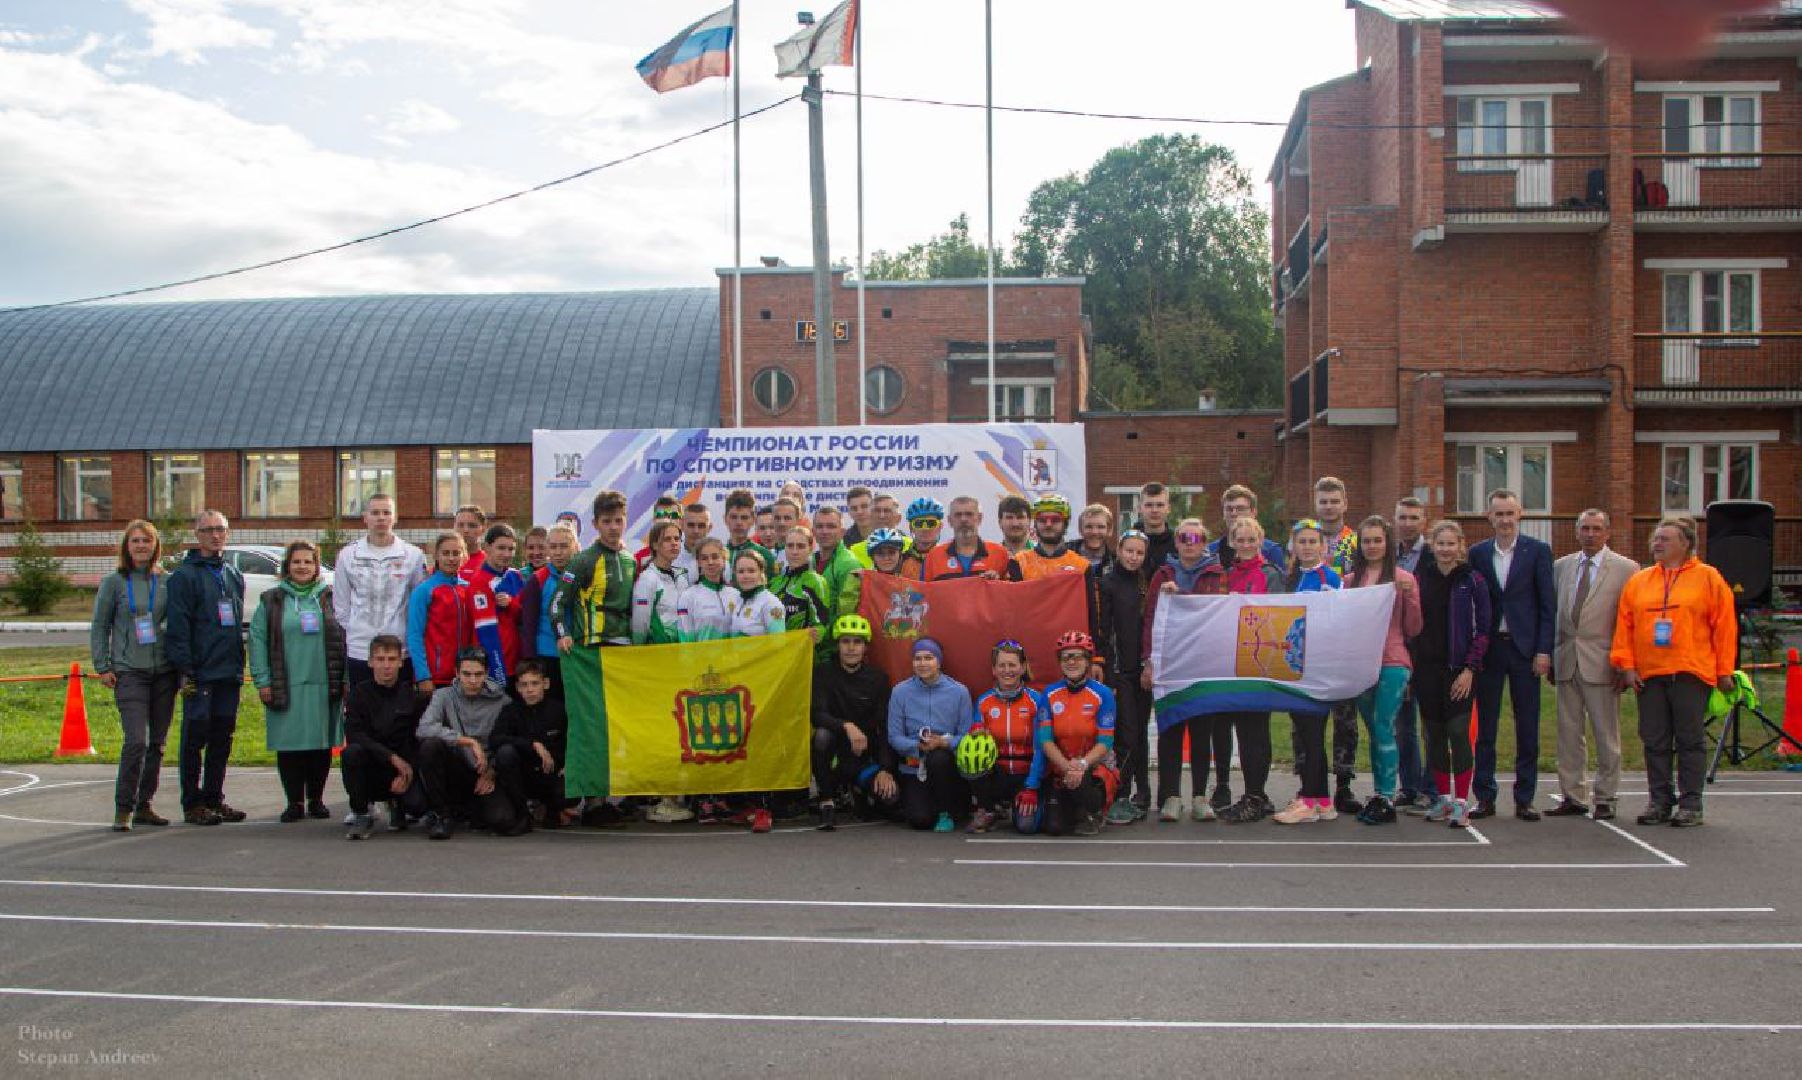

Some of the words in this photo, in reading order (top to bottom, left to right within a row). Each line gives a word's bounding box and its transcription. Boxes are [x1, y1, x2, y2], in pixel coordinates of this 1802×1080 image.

[687, 436, 823, 452] ЧЕМПИОНАТ
[829, 435, 920, 451] РОССИИ
[646, 458, 678, 474] ПО
[684, 456, 848, 473] СПОРТИВНОМУ
[854, 455, 958, 472] ТУРИЗМУ
[657, 480, 673, 489] на
[756, 479, 772, 488] на
[776, 478, 844, 488] сдствах
